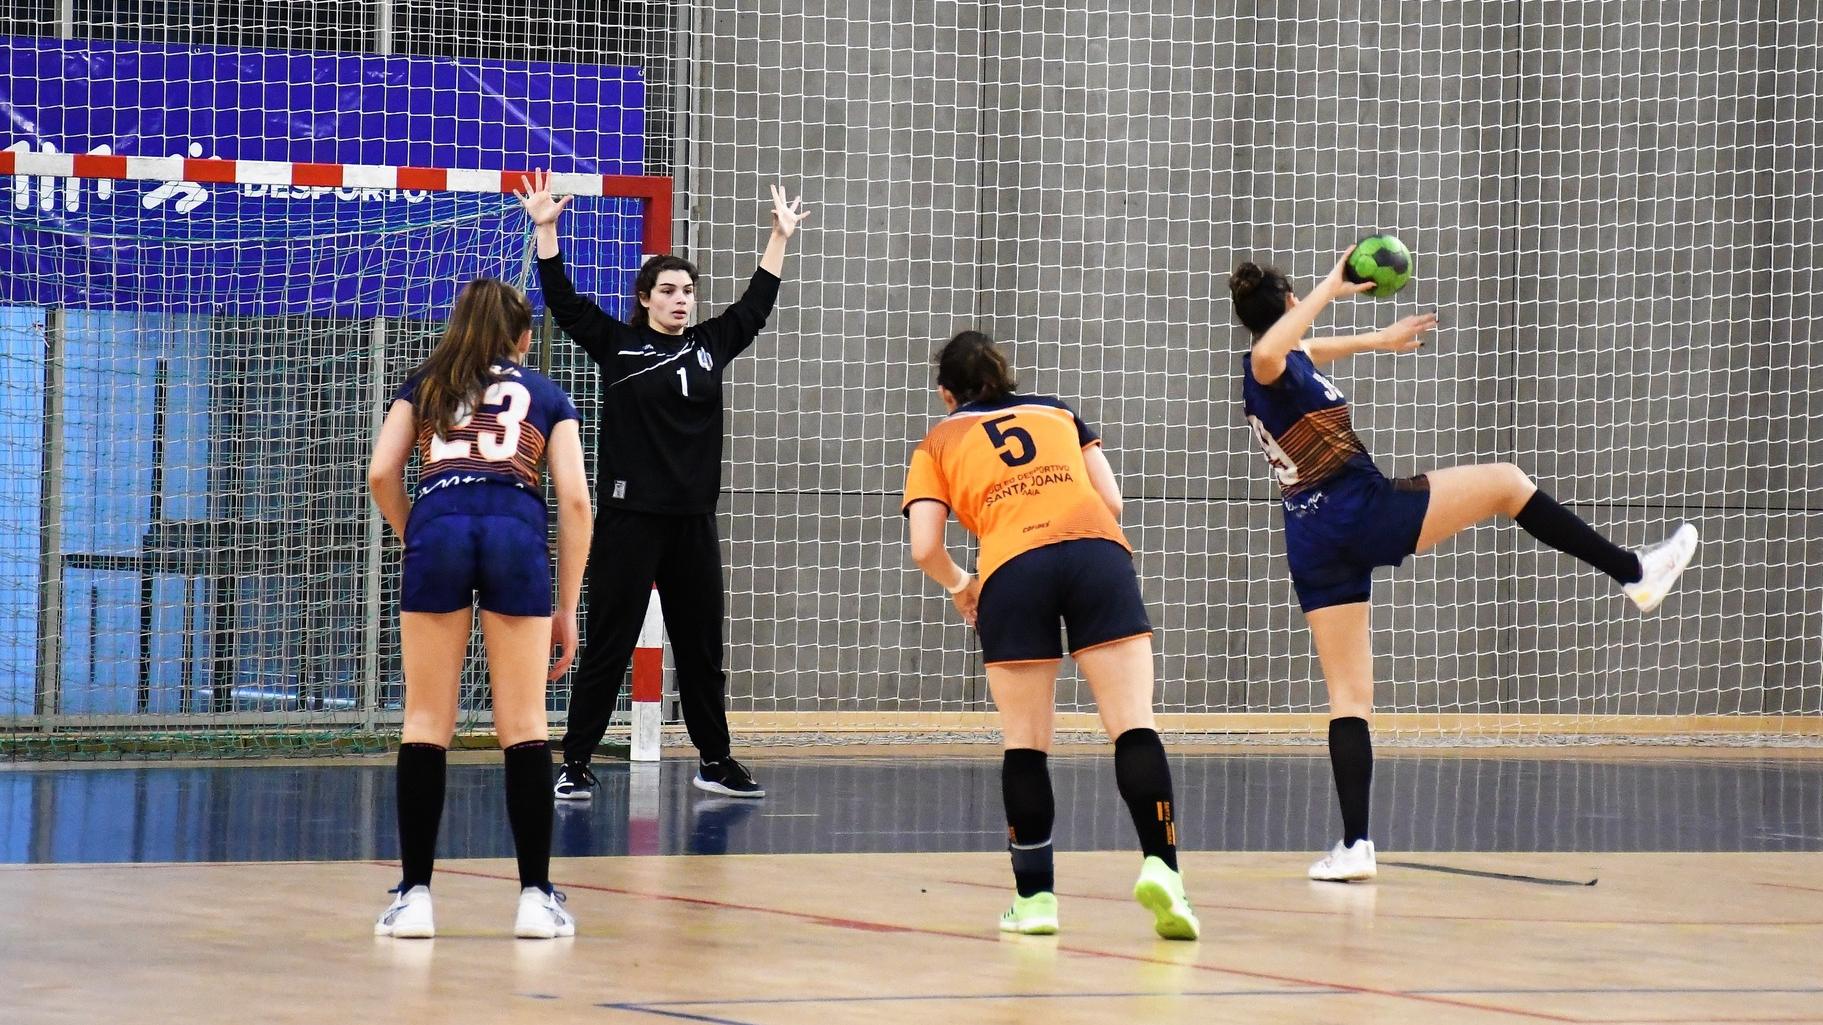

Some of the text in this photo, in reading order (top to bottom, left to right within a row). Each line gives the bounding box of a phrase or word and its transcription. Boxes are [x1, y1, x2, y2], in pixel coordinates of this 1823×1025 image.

[676, 367, 689, 397] 1
[430, 381, 531, 462] 23
[982, 413, 1037, 468] 5
[985, 472, 1074, 507] SANTA JOANA
